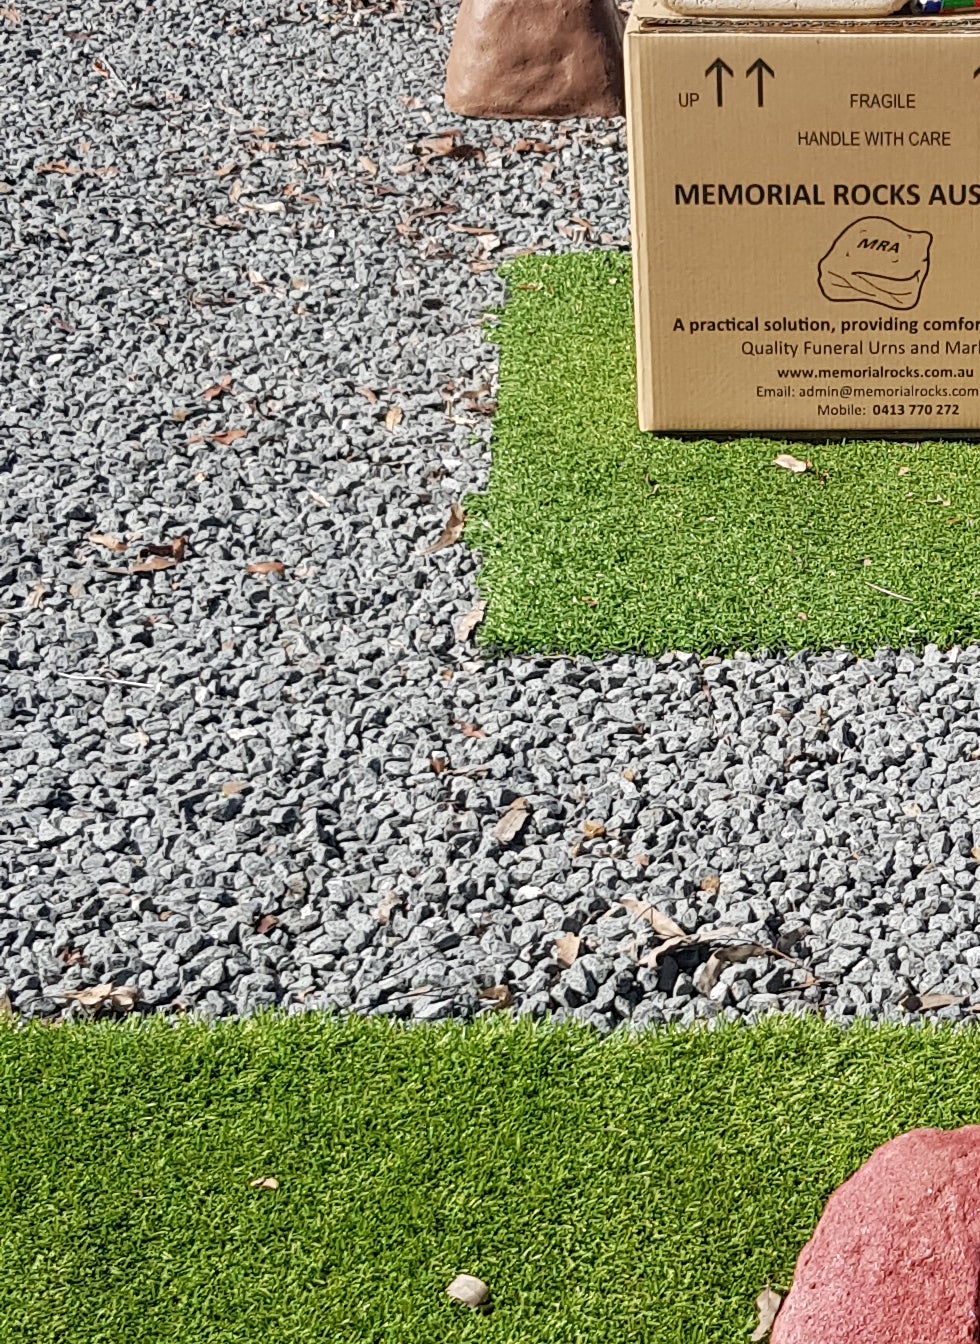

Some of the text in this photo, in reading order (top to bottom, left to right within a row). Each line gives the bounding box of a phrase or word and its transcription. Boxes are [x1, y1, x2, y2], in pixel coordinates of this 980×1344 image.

[679, 93, 699, 108] UP
[851, 94, 916, 109] FRAGILE
[797, 131, 951, 147] HANDLE WITH CARE
[674, 184, 826, 206] MEMORIAL
[833, 184, 921, 206] ROCKS
[857, 238, 900, 254] MRA
[672, 318, 685, 332] A
[689, 316, 759, 334] practical
[763, 316, 836, 334] solution,
[841, 316, 919, 335] providing
[741, 341, 799, 358] Quality
[803, 340, 864, 355] Funeral
[868, 341, 905, 355] Urns
[910, 340, 940, 355] and
[777, 365, 974, 379] www.memorialrocks.com.au
[756, 385, 795, 398] Email:
[817, 404, 960, 416] Mobile: 0413 770 272
